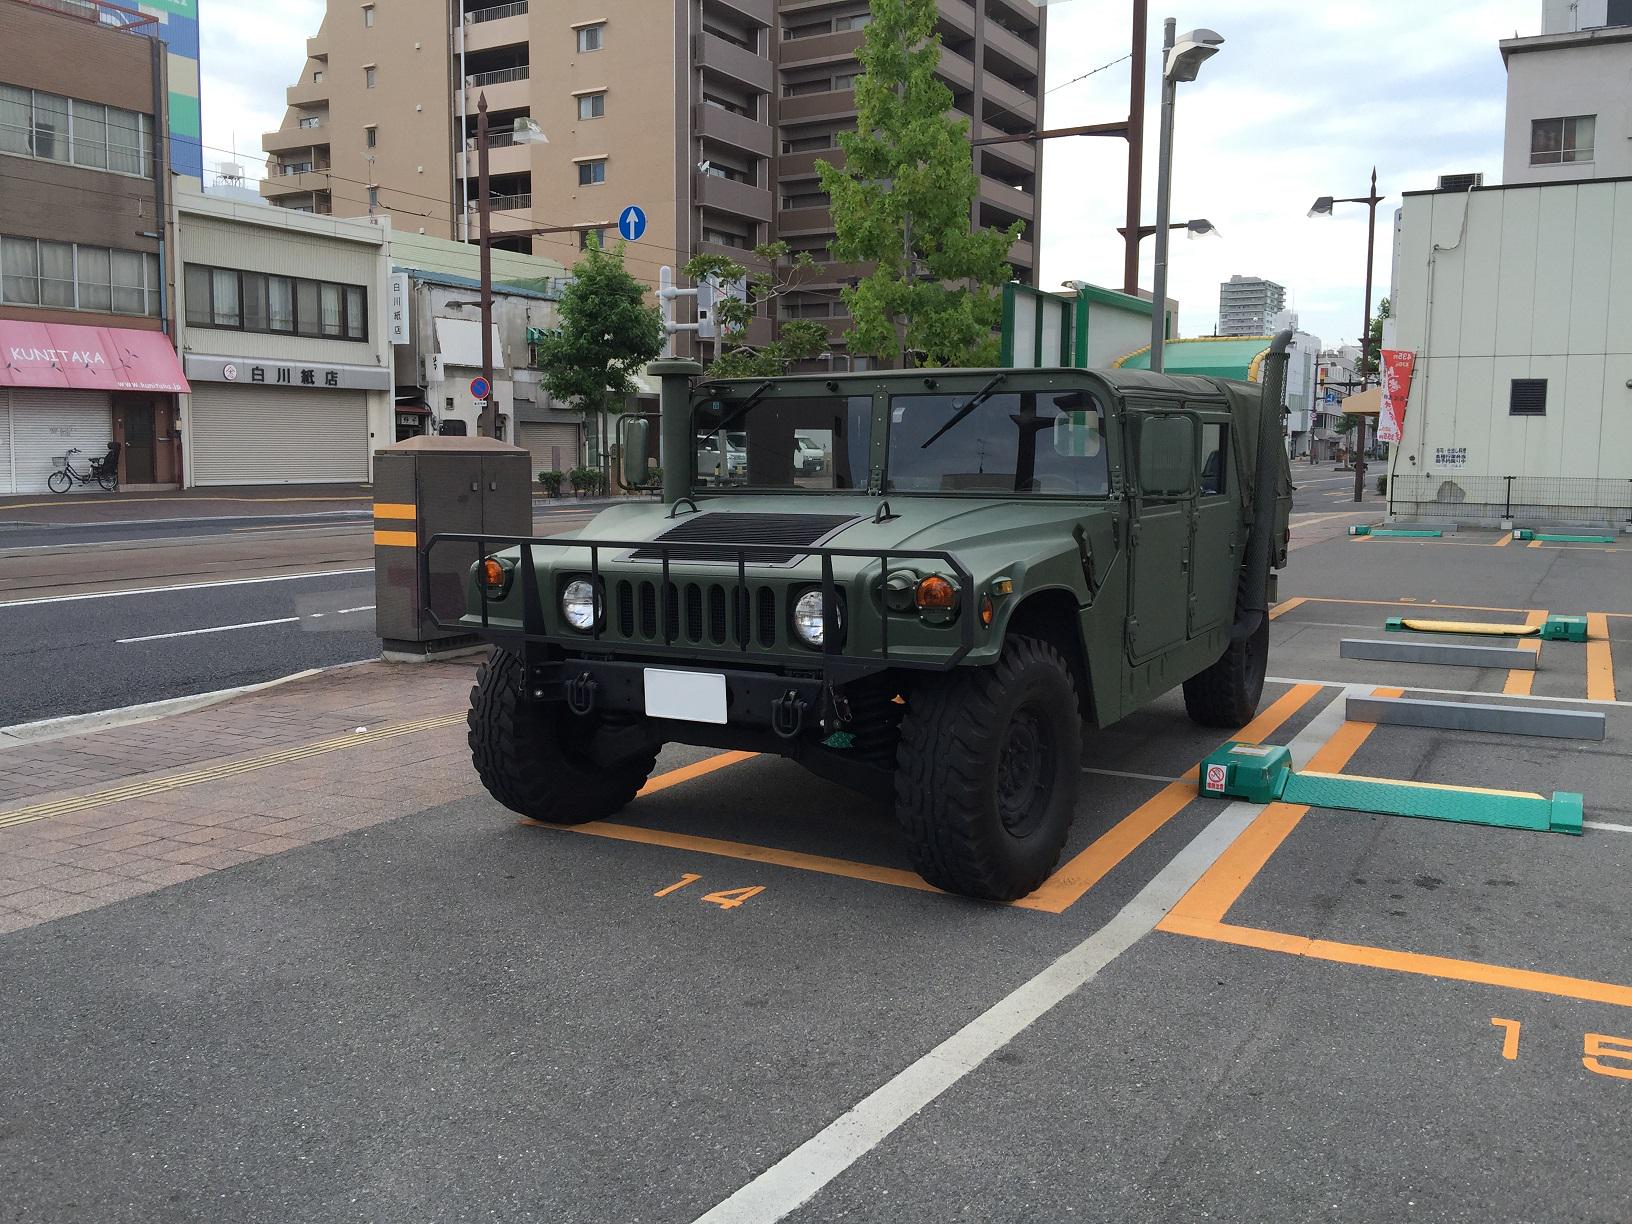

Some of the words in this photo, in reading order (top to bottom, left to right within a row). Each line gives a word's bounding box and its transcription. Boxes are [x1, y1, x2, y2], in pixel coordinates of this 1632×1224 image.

[393, 281, 402, 335] 白川紙店
[9, 346, 105, 365] KUNITAKA
[117, 381, 181, 391] www.kunitaka.jp
[251, 366, 339, 386] 白川紙店
[653, 873, 767, 910] 14
